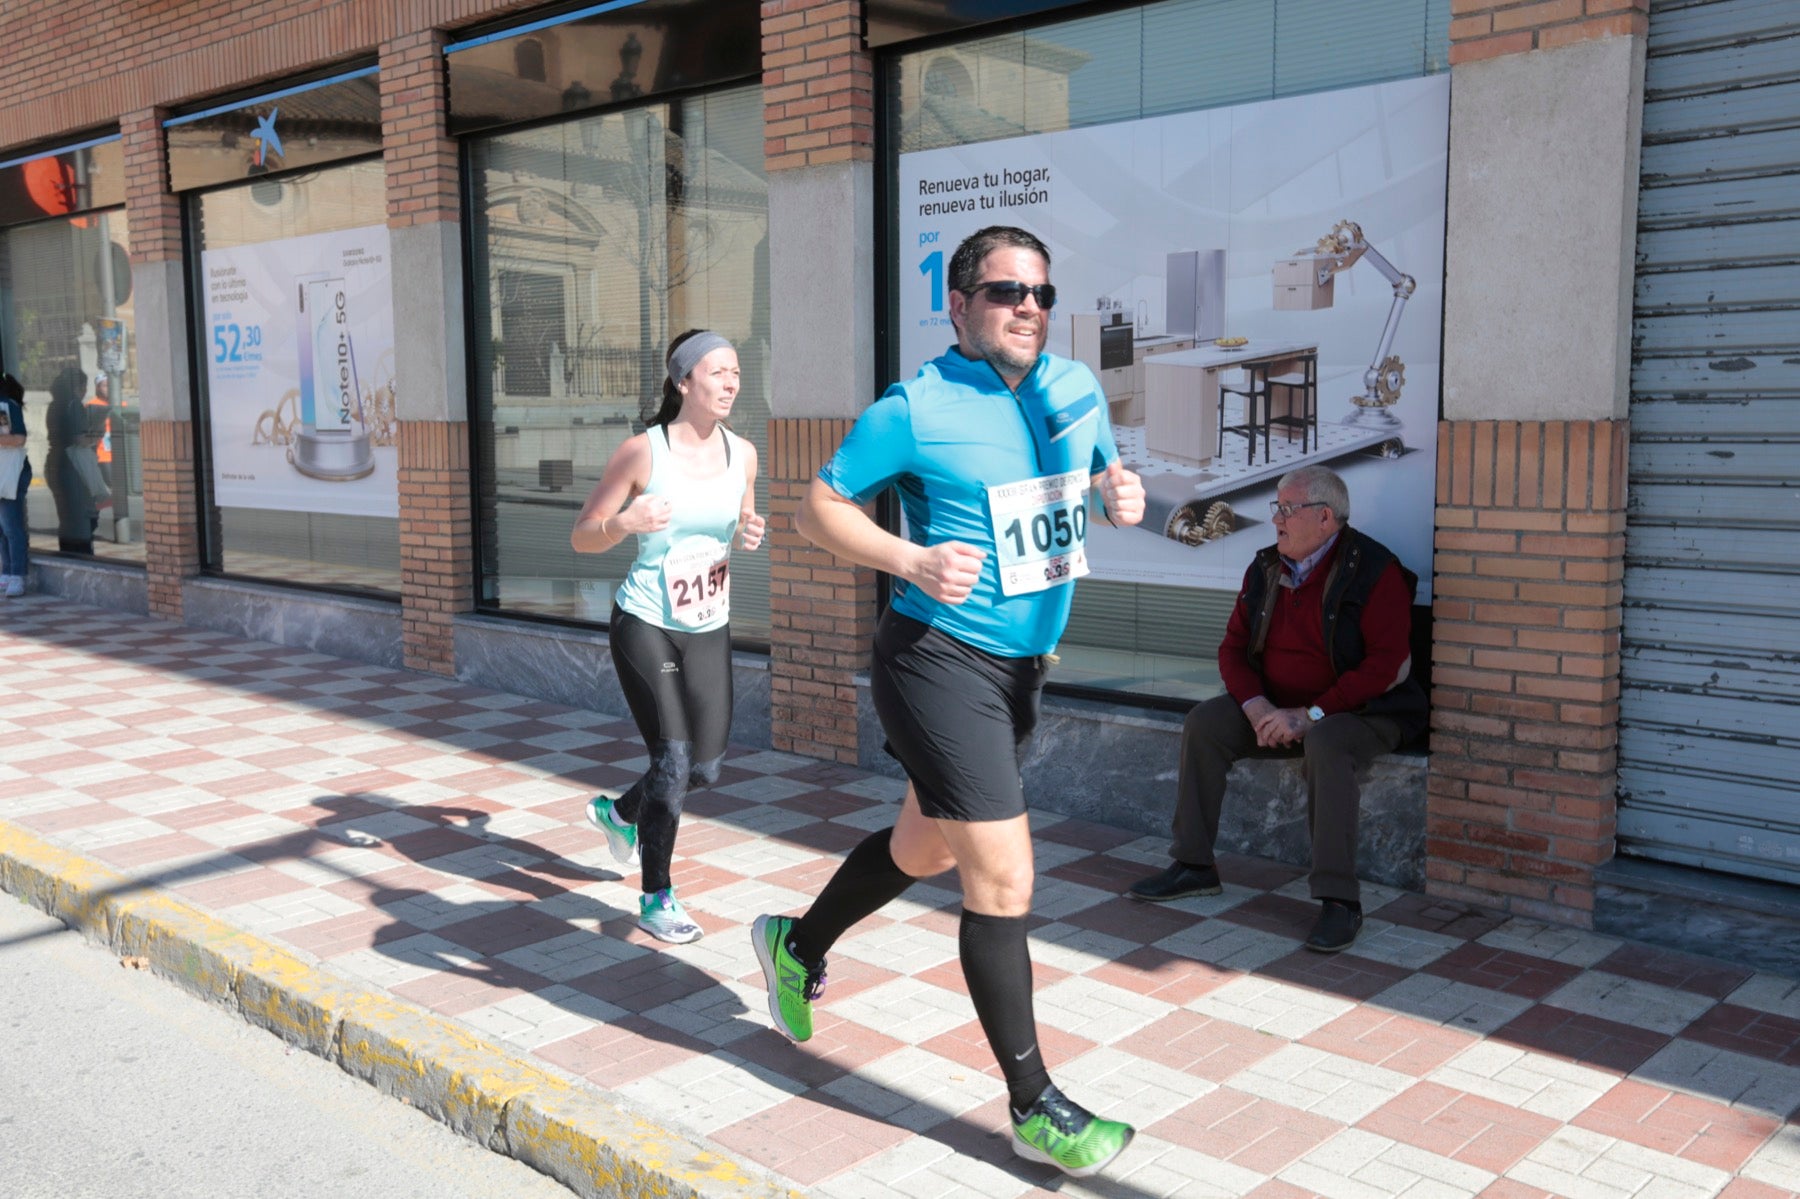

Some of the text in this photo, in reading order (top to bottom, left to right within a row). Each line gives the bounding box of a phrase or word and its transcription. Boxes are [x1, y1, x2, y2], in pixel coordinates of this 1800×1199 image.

[920, 167, 1050, 196] Renueva tu hogar,
[919, 186, 1048, 216] renueva tu ilusión
[919, 231, 940, 247] por
[335, 290, 351, 424] Note10+ 5G
[1004, 504, 1086, 557] 1050
[672, 564, 727, 607] 2157
